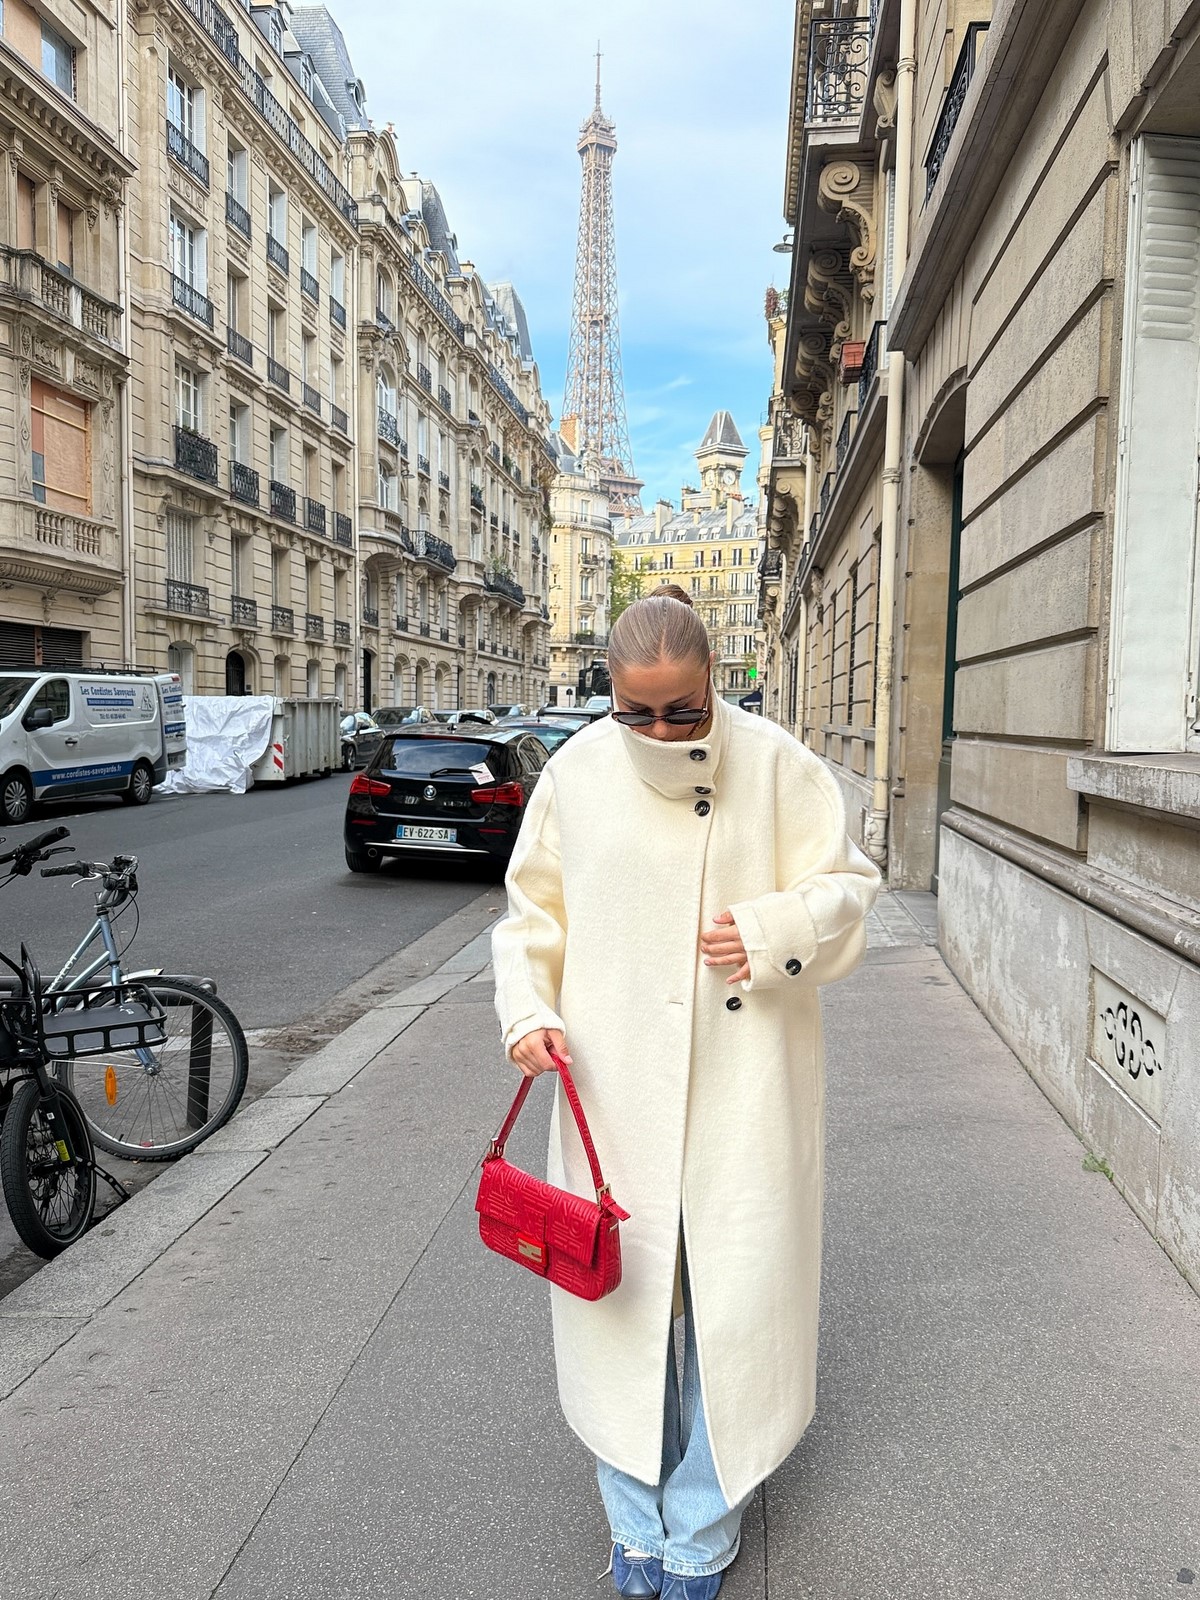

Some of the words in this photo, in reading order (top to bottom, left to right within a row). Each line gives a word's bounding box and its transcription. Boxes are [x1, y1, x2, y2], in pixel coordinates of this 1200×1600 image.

[80, 686, 90, 695] Les
[90, 686, 113, 696] Cordistes
[113, 687, 137, 698] Savoyards
[51, 764, 122, 780] www.cordistes-savoyards.fr
[403, 827, 449, 840] EV-622-SA
